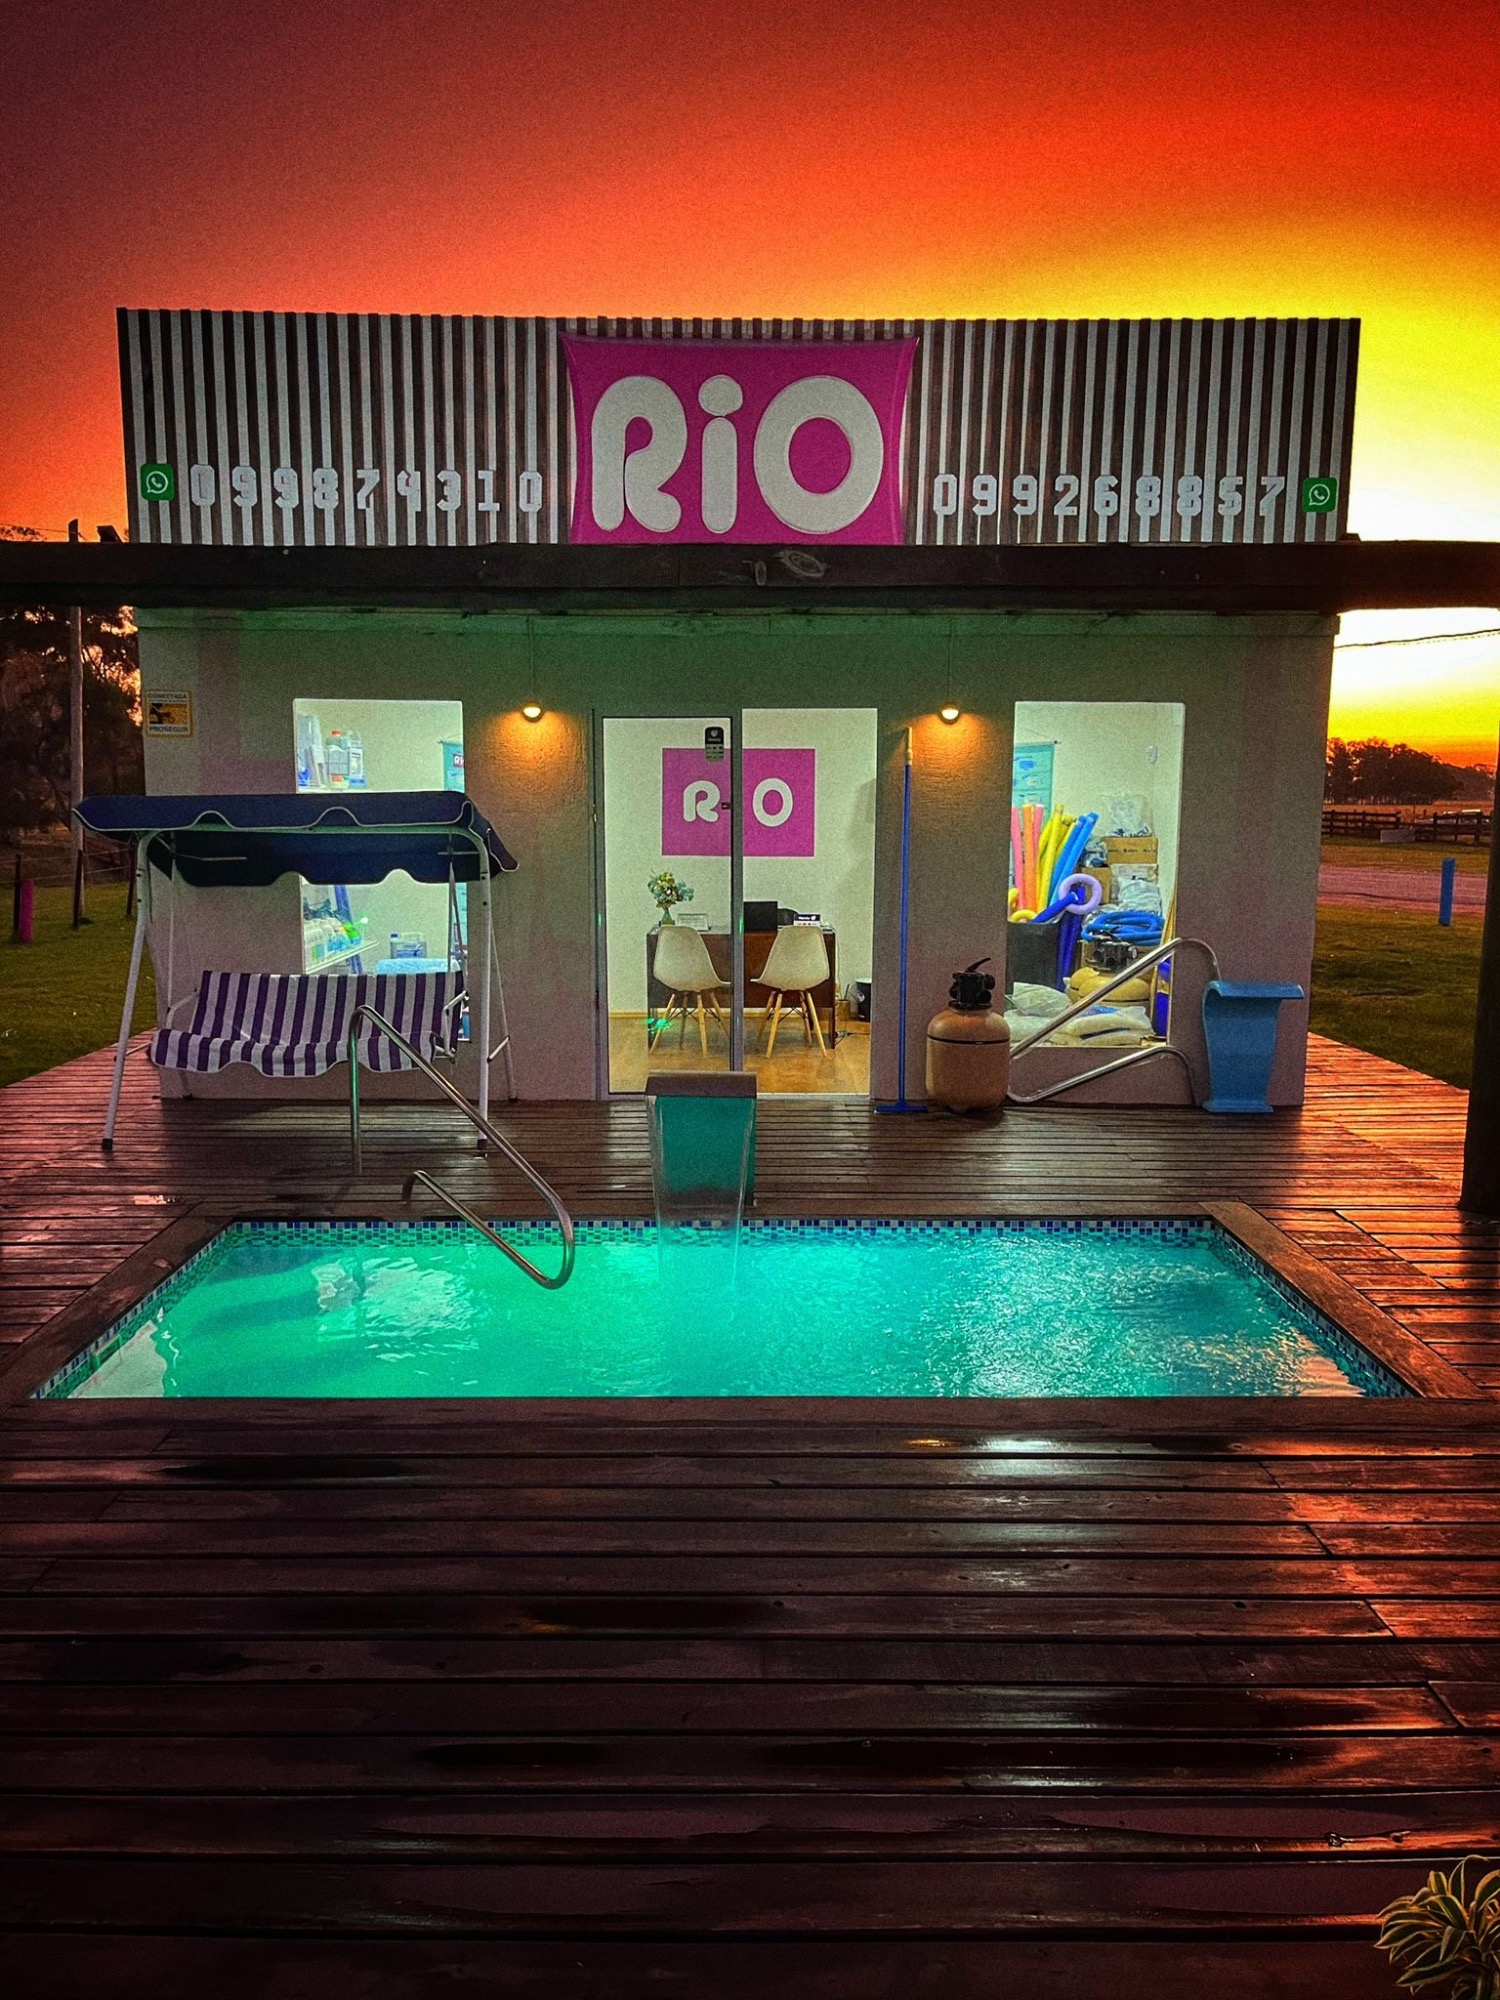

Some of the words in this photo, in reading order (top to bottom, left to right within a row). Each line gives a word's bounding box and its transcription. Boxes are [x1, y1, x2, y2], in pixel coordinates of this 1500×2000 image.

[190, 464, 542, 512] 099874310
[933, 473, 1285, 516] 099268857
[683, 778, 793, 827] RO
